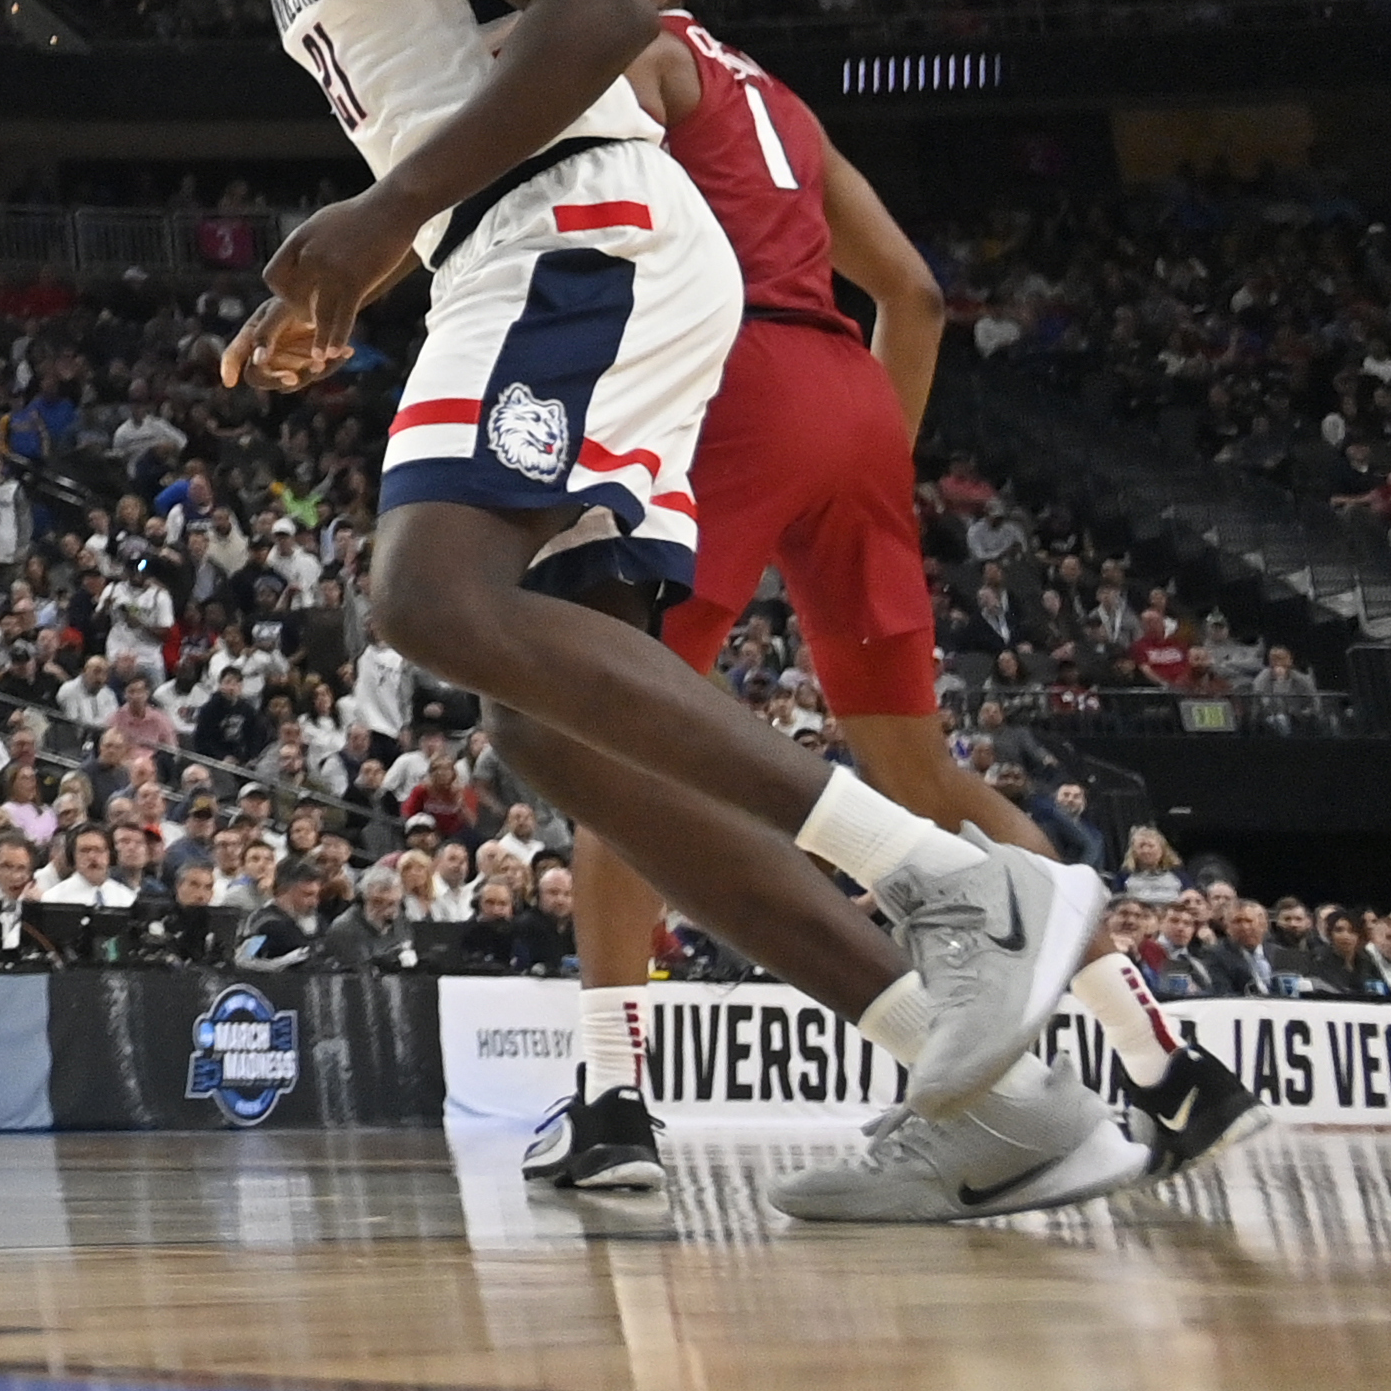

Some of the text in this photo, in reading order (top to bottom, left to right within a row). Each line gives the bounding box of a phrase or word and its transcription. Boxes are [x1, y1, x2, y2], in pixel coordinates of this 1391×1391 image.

[744, 82, 800, 190] 1
[214, 1021, 271, 1051] MARCH
[477, 1027, 573, 1058] HOSTED BY
[223, 1050, 296, 1080] MADNESS
[644, 1003, 909, 1104] NIVERSI
